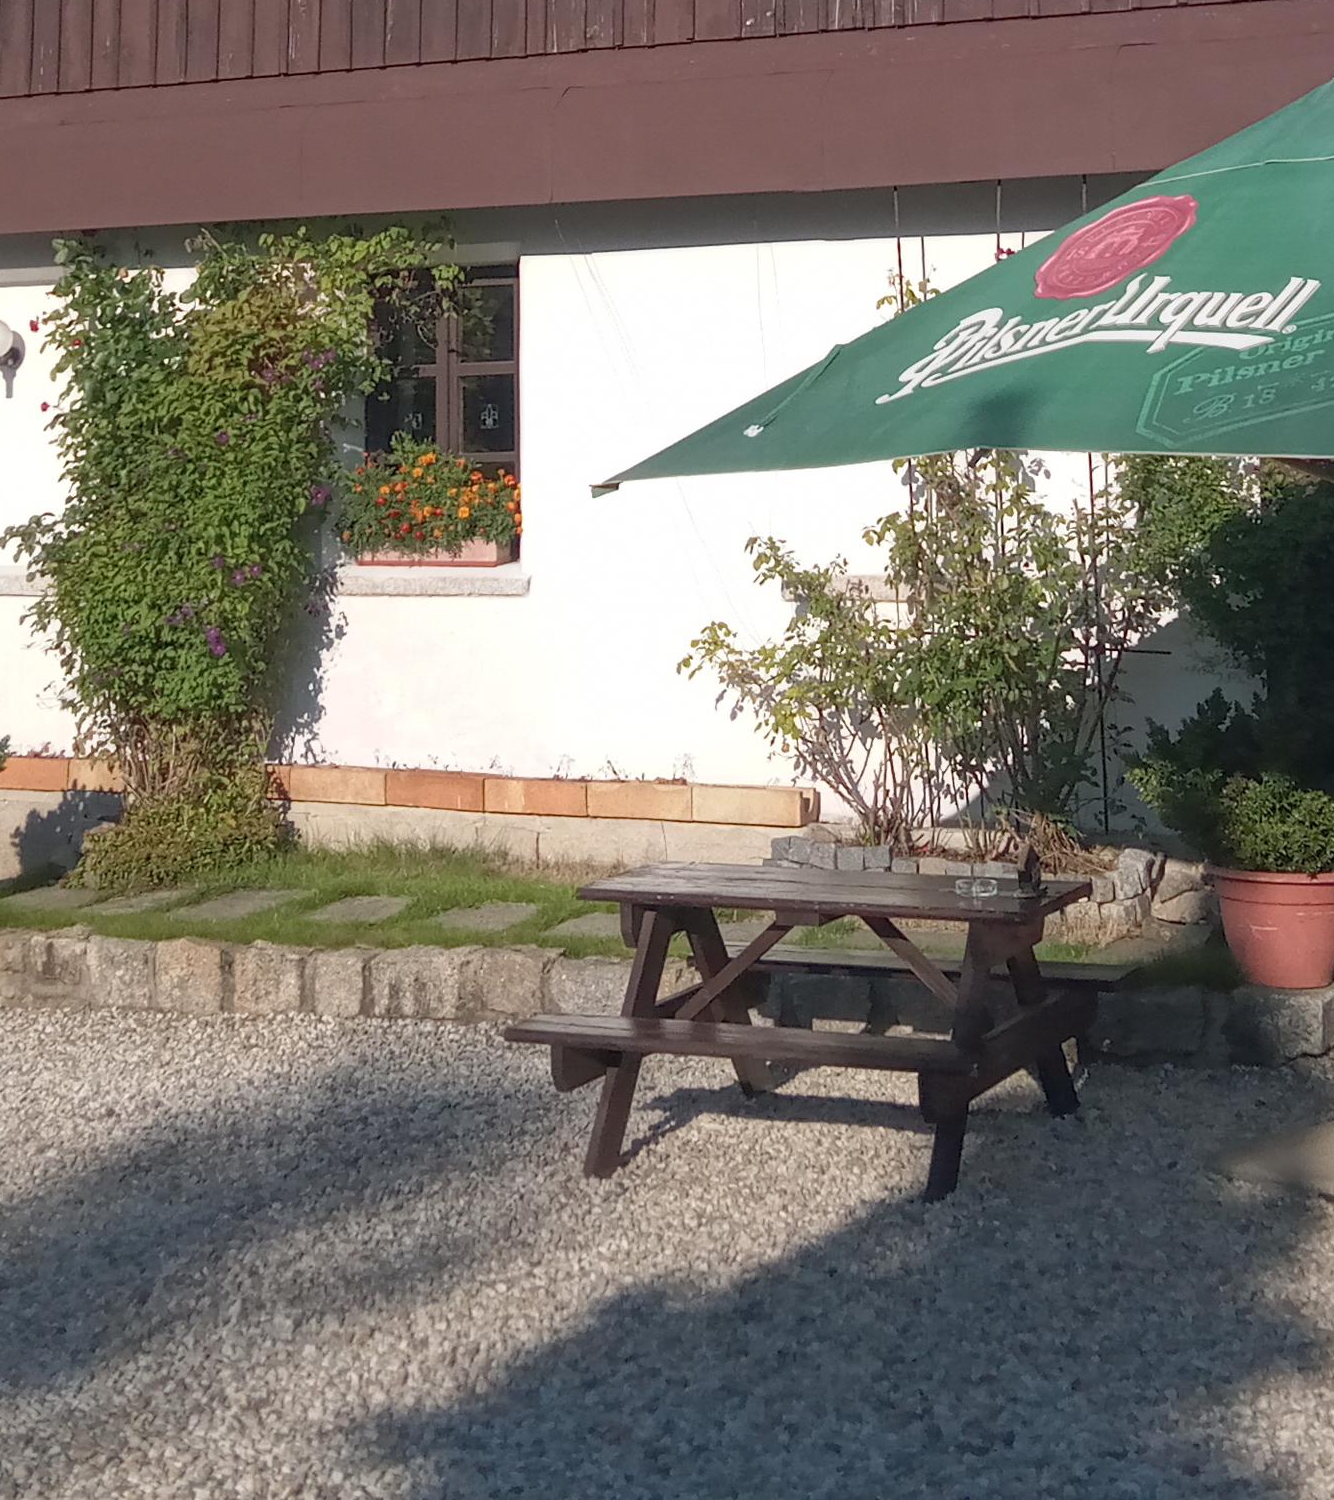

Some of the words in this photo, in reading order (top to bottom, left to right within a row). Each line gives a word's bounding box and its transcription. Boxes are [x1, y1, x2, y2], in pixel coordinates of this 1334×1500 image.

[877, 300, 1114, 404] Pilsner
[1103, 273, 1322, 354] Urquell
[1173, 348, 1325, 396] Pilsner
